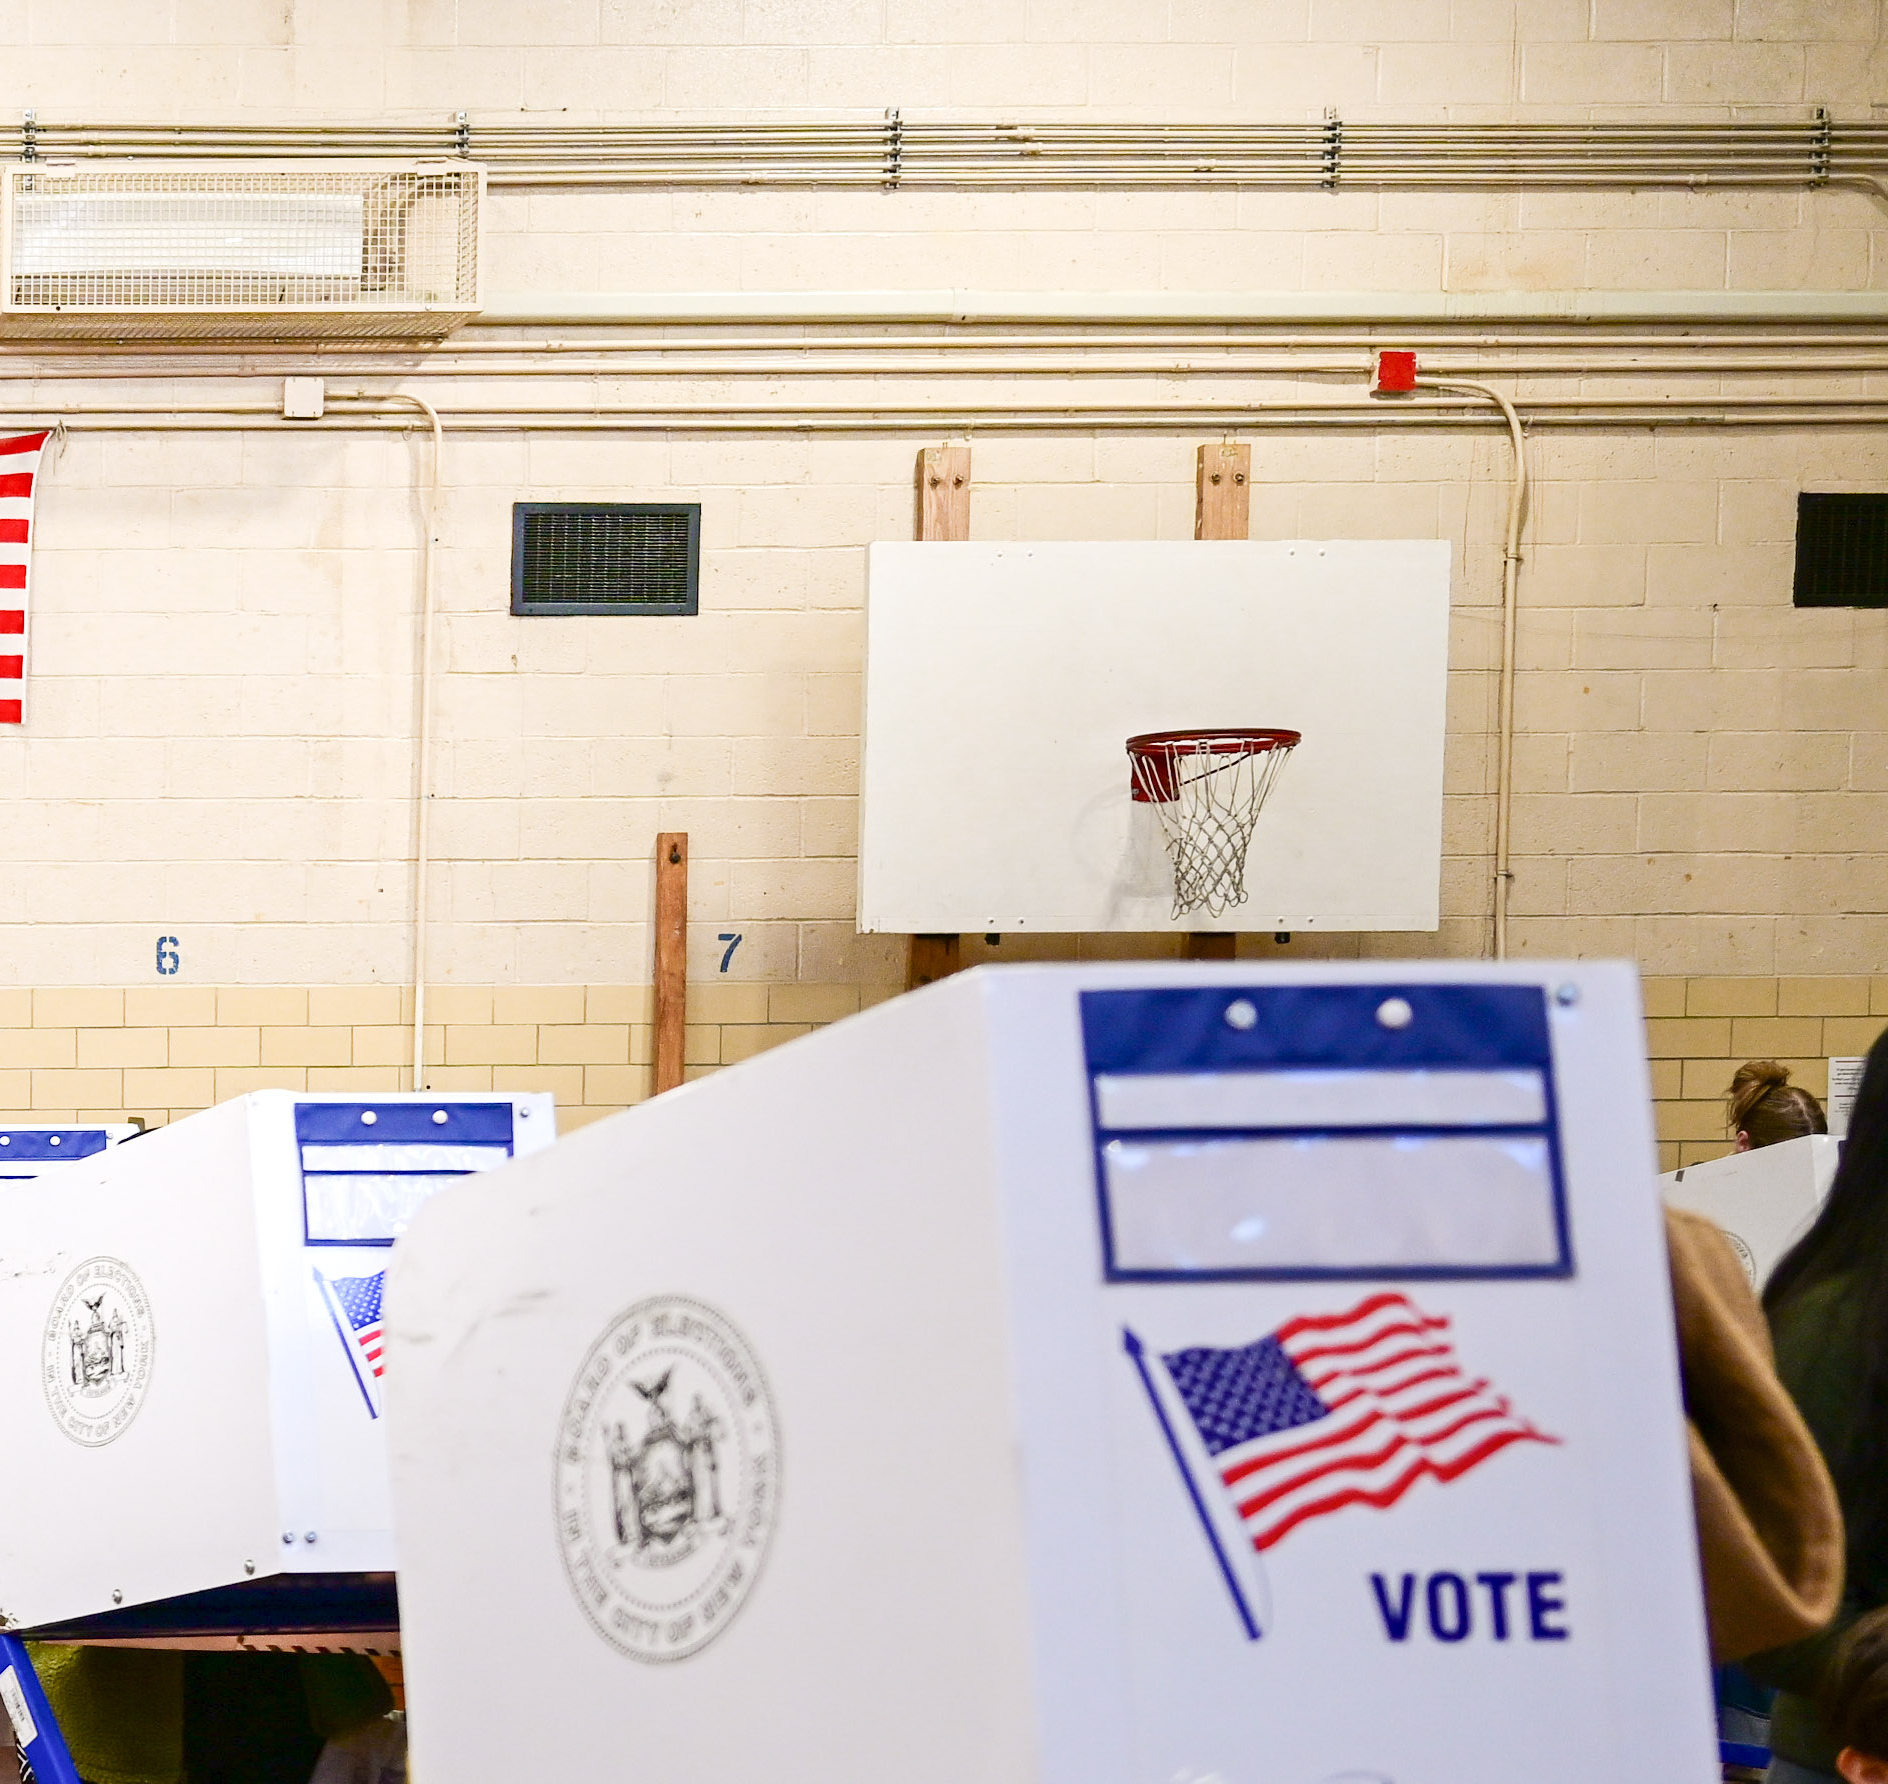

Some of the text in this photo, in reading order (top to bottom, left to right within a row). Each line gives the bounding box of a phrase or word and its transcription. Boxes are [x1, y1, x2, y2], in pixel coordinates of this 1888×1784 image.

[156, 936, 178, 974] 6
[718, 933, 742, 972] 7
[1370, 1571, 1571, 1643] VOTE
